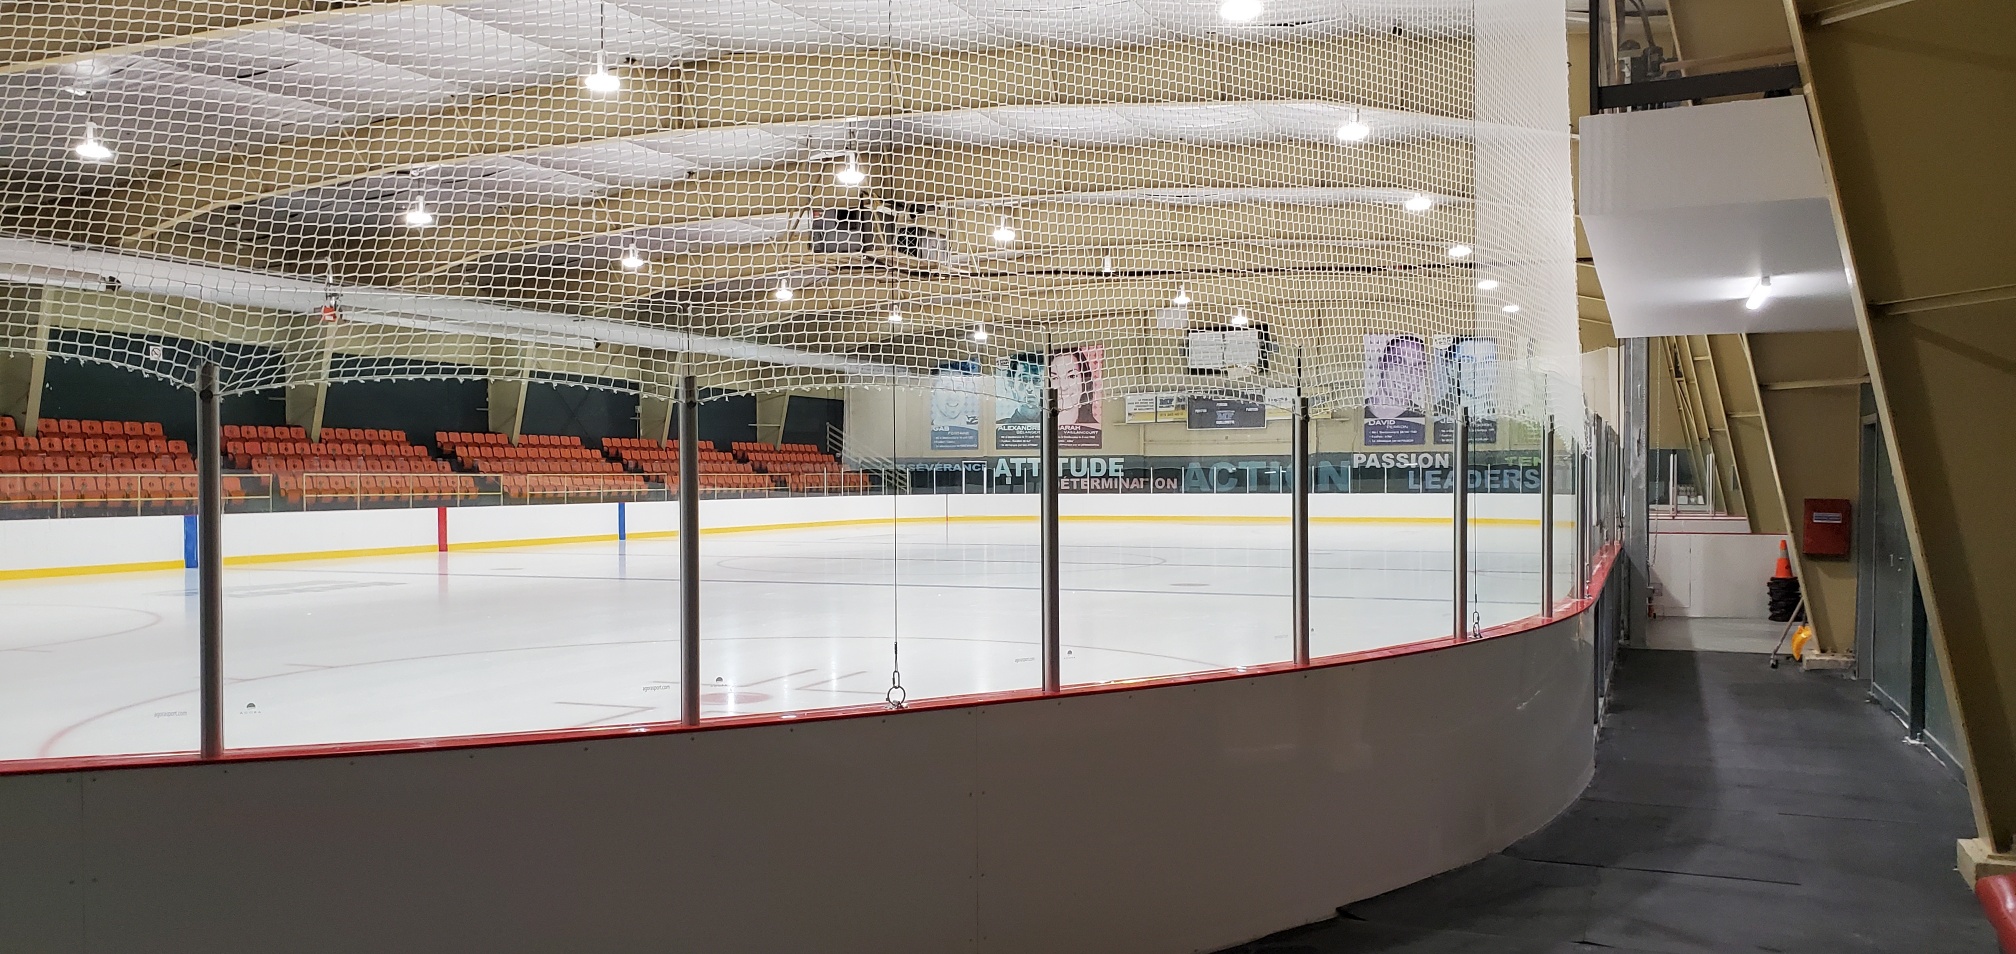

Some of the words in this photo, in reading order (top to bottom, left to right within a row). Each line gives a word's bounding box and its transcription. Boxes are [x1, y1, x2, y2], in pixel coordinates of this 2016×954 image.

[891, 462, 987, 472] RSÉVÉRANC
[995, 457, 1125, 477] ATTTUDE
[1352, 453, 1449, 469] PASSION
[1504, 456, 1542, 467] TEN
[1058, 476, 1178, 490] ÉTERMINATON
[1184, 460, 1350, 492] ACTIN
